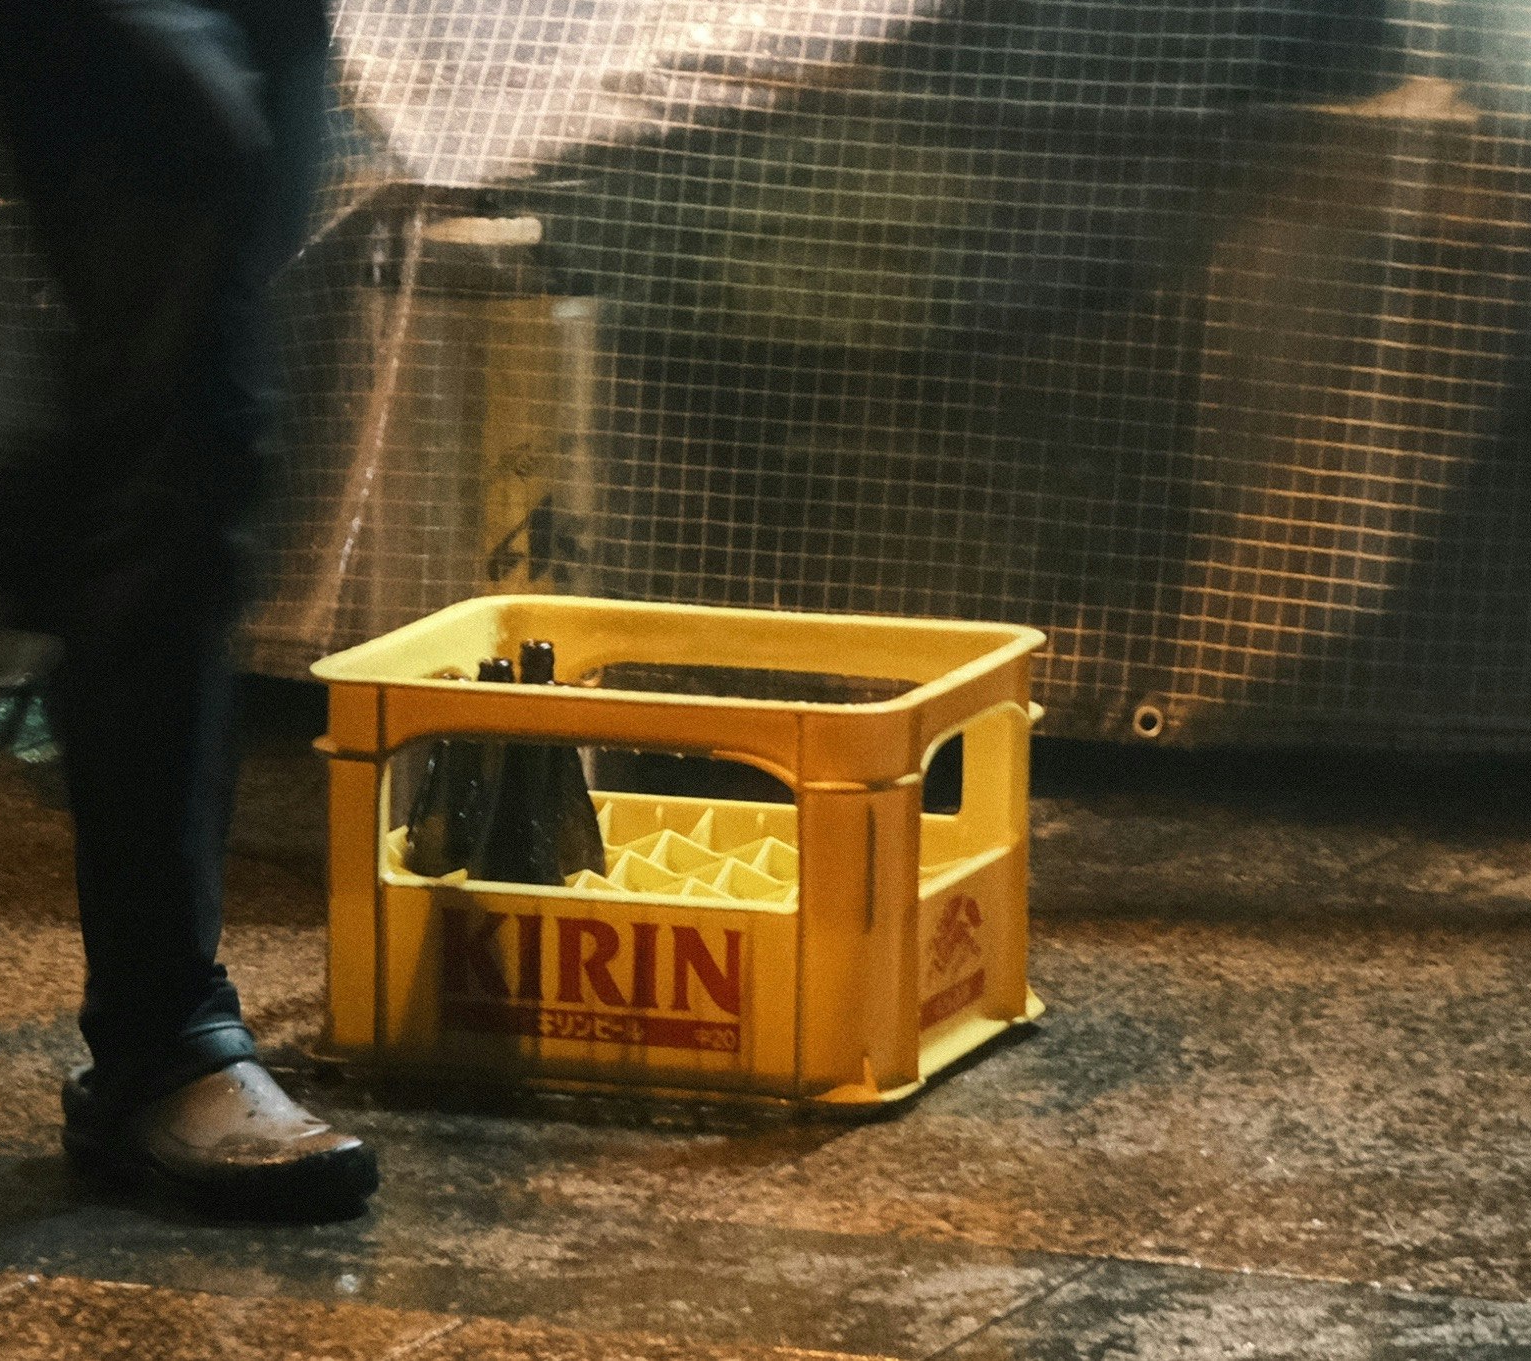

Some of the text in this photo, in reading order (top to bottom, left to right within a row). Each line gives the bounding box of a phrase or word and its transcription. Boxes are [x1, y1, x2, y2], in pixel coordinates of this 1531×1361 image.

[441, 907, 745, 1016] KIRIN
[538, 1010, 645, 1043] キリンビール
